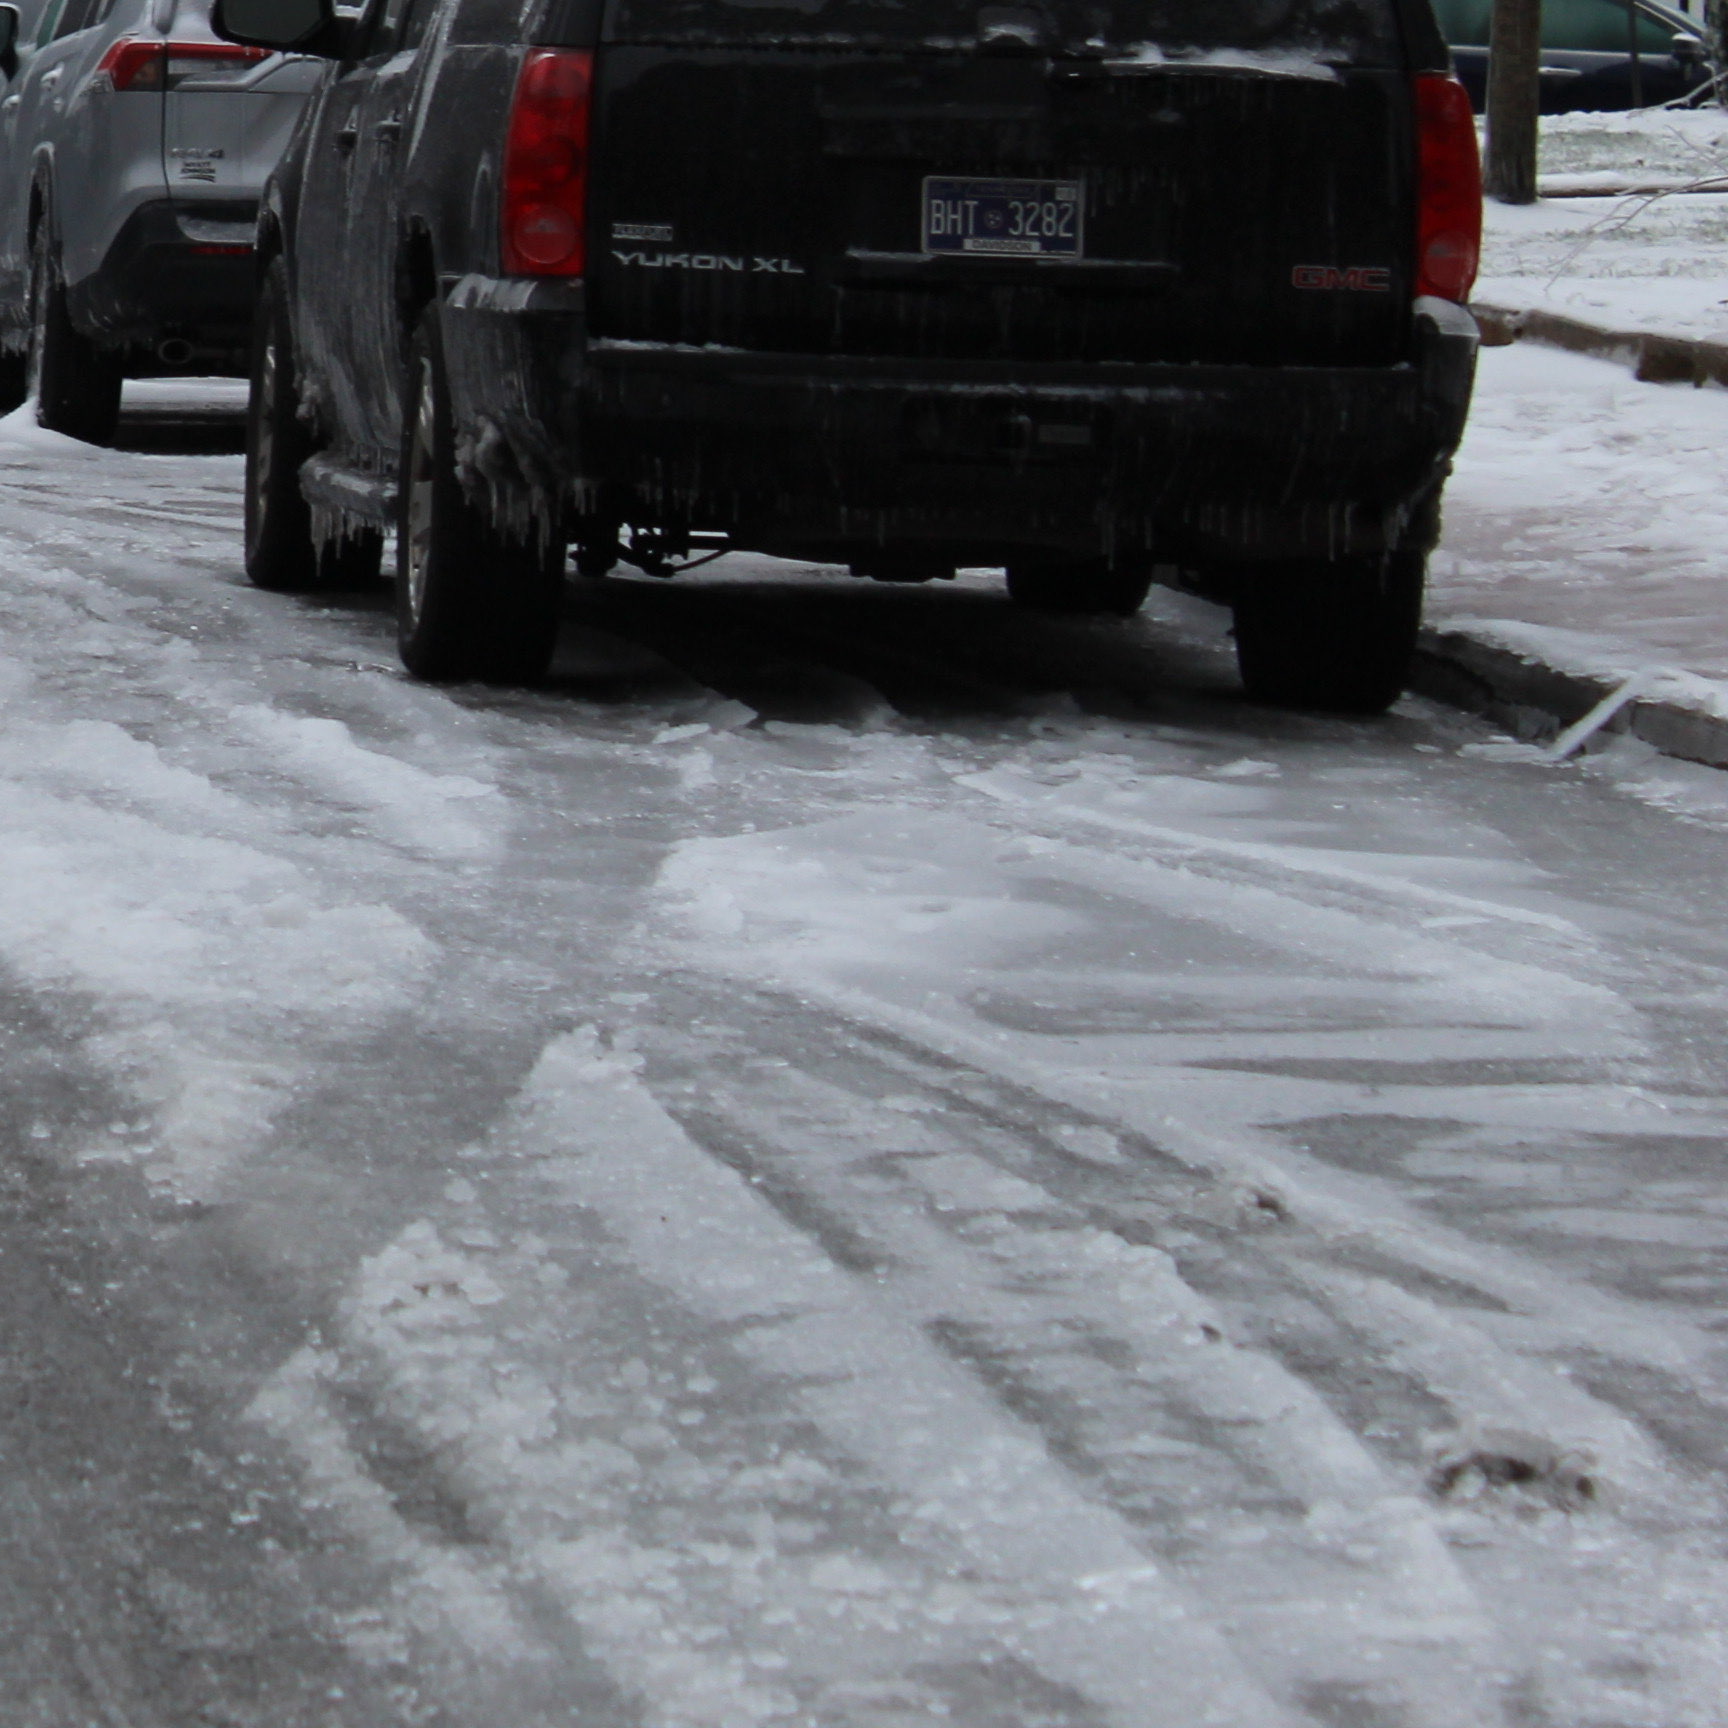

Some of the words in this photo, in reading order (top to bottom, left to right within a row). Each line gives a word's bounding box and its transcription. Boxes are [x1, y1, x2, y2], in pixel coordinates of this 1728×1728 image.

[930, 199, 979, 235] BHT
[1008, 201, 1074, 238] 3282
[610, 250, 744, 272] YUKON
[752, 257, 805, 274] XL
[1291, 265, 1391, 291] GMC
